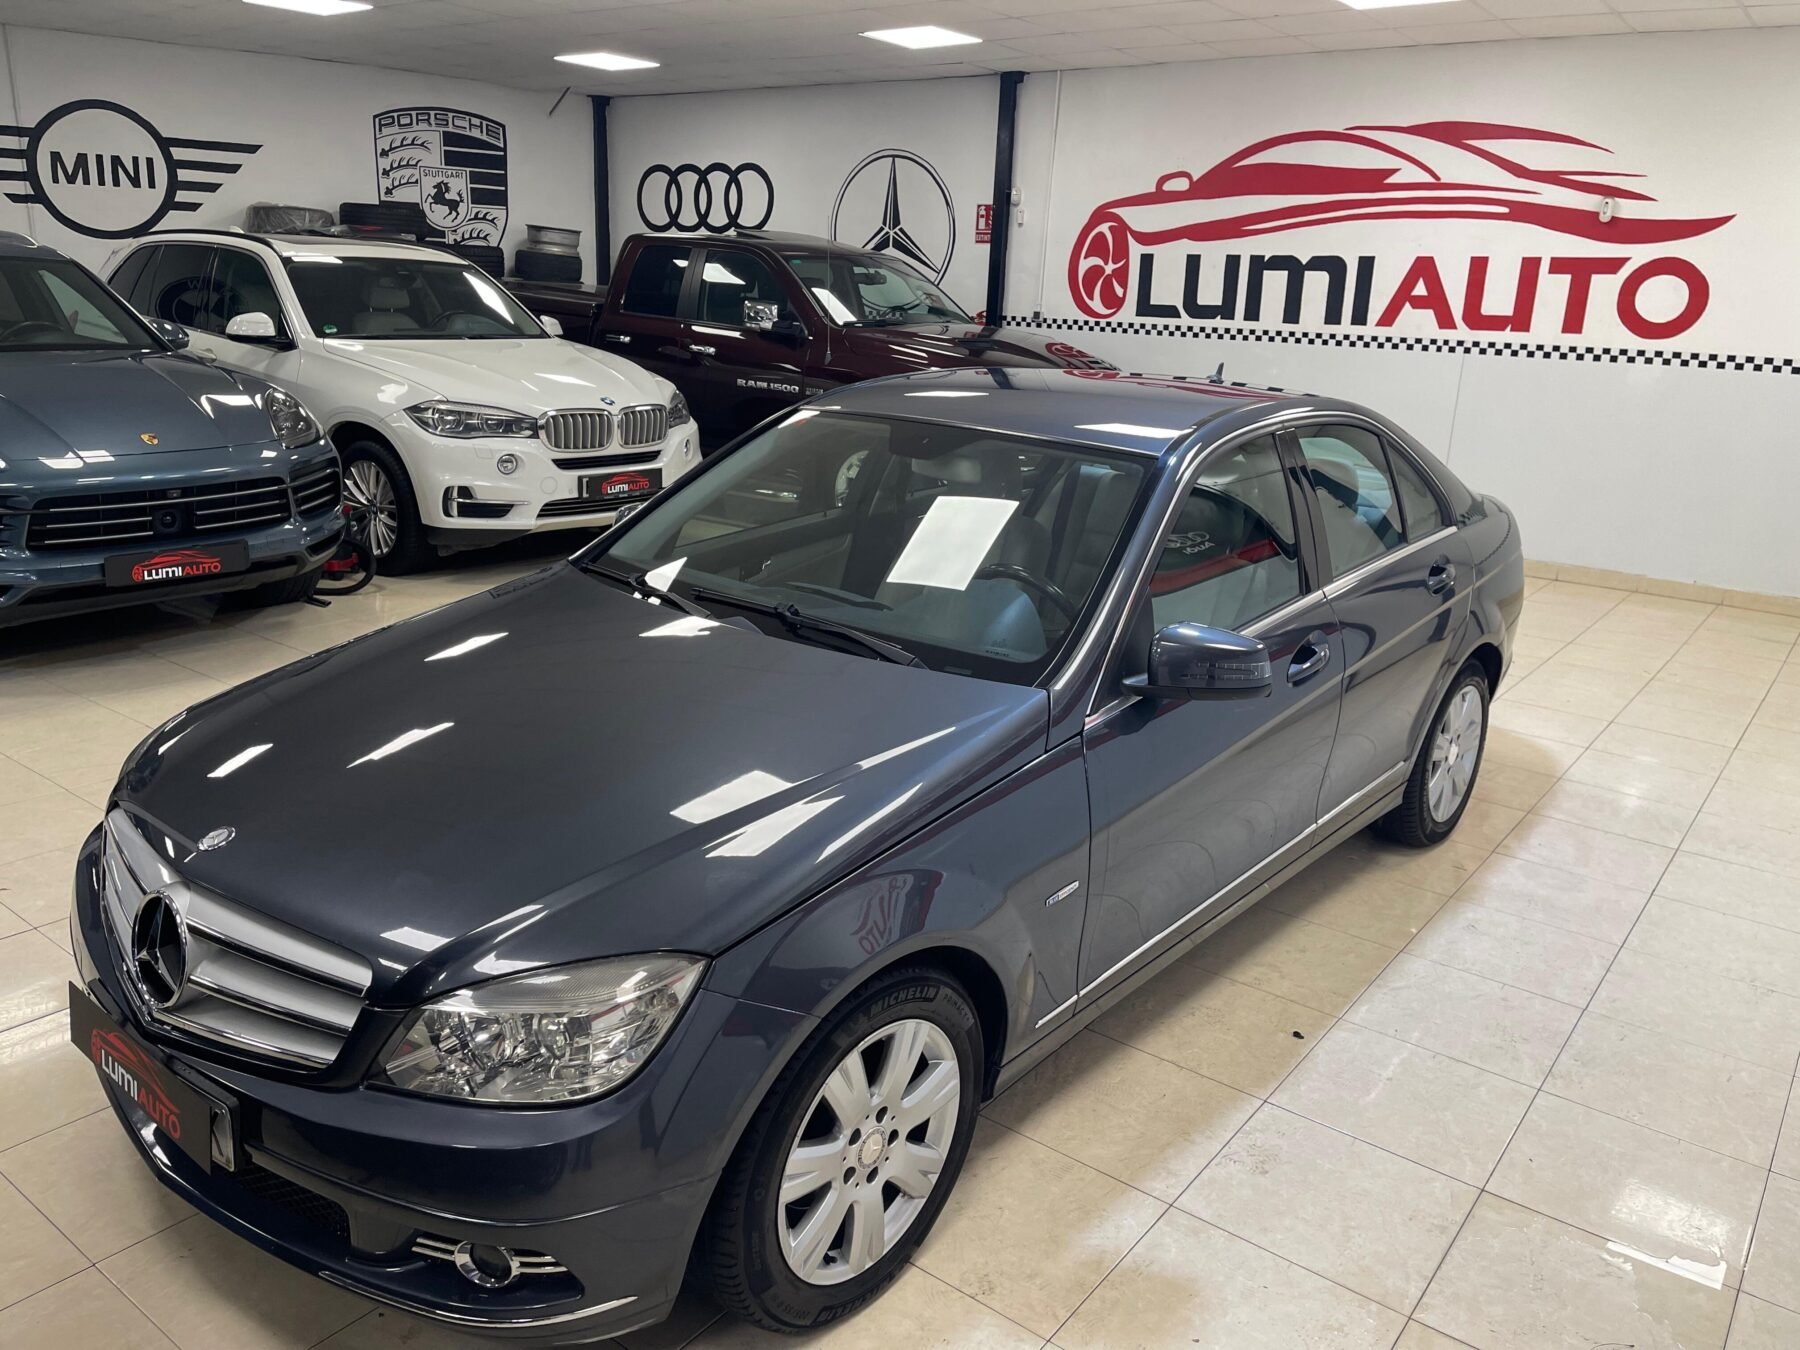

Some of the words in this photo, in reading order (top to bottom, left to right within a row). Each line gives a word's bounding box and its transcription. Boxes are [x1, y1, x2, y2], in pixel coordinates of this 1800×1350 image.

[378, 111, 502, 142] PORSCHE
[50, 150, 156, 189] MINI
[423, 169, 464, 180] STUTTGART
[1135, 254, 1710, 340] LUMIAUTO
[736, 378, 768, 390] RAM
[770, 382, 799, 394] 1500
[607, 481, 650, 494] LUMIAUTO
[143, 562, 222, 581] LUMIAUTO
[870, 985, 938, 1017] MICHELIN
[101, 1049, 181, 1142] LUMIAUTO
